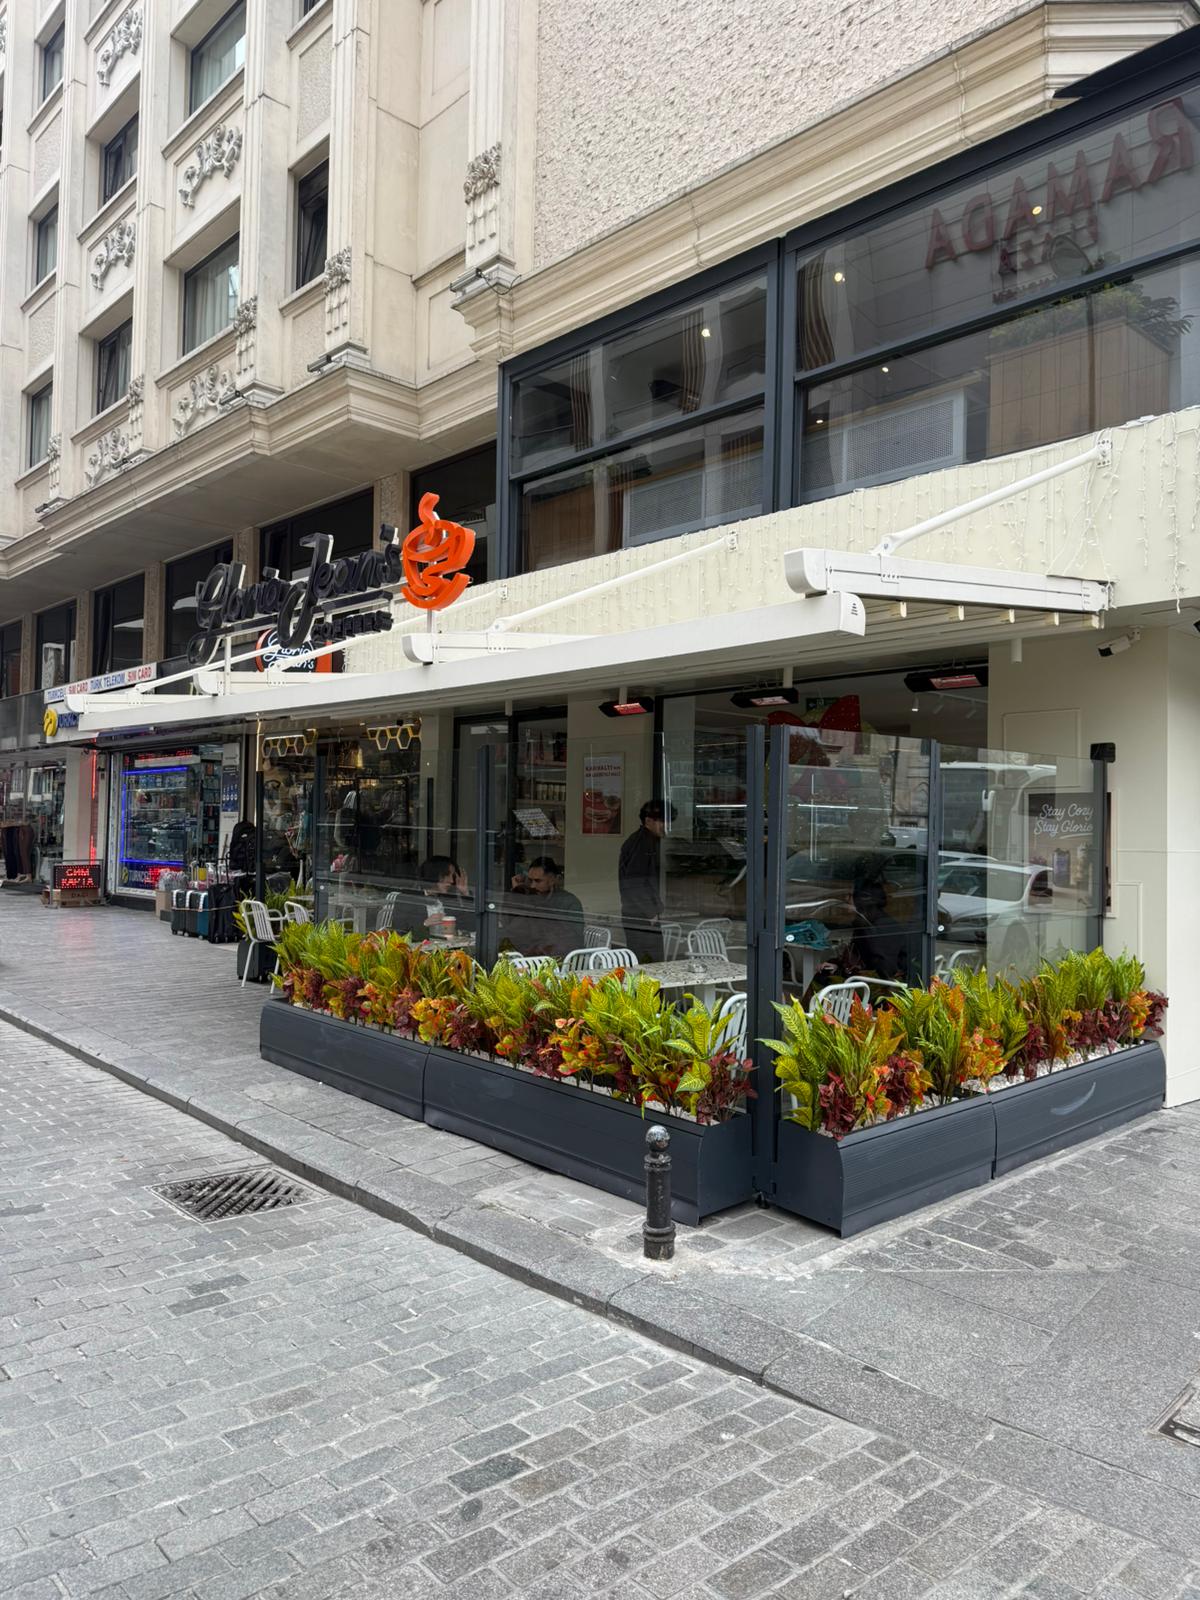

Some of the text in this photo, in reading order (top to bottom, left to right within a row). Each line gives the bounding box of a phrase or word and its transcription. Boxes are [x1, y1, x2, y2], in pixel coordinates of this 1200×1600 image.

[77, 682, 88, 693] CARD
[103, 673, 125, 688] TELEKOM
[138, 666, 152, 678] CARD
[1040, 803, 1093, 820] Stay Cozy
[1034, 820, 1058, 837] Stay
